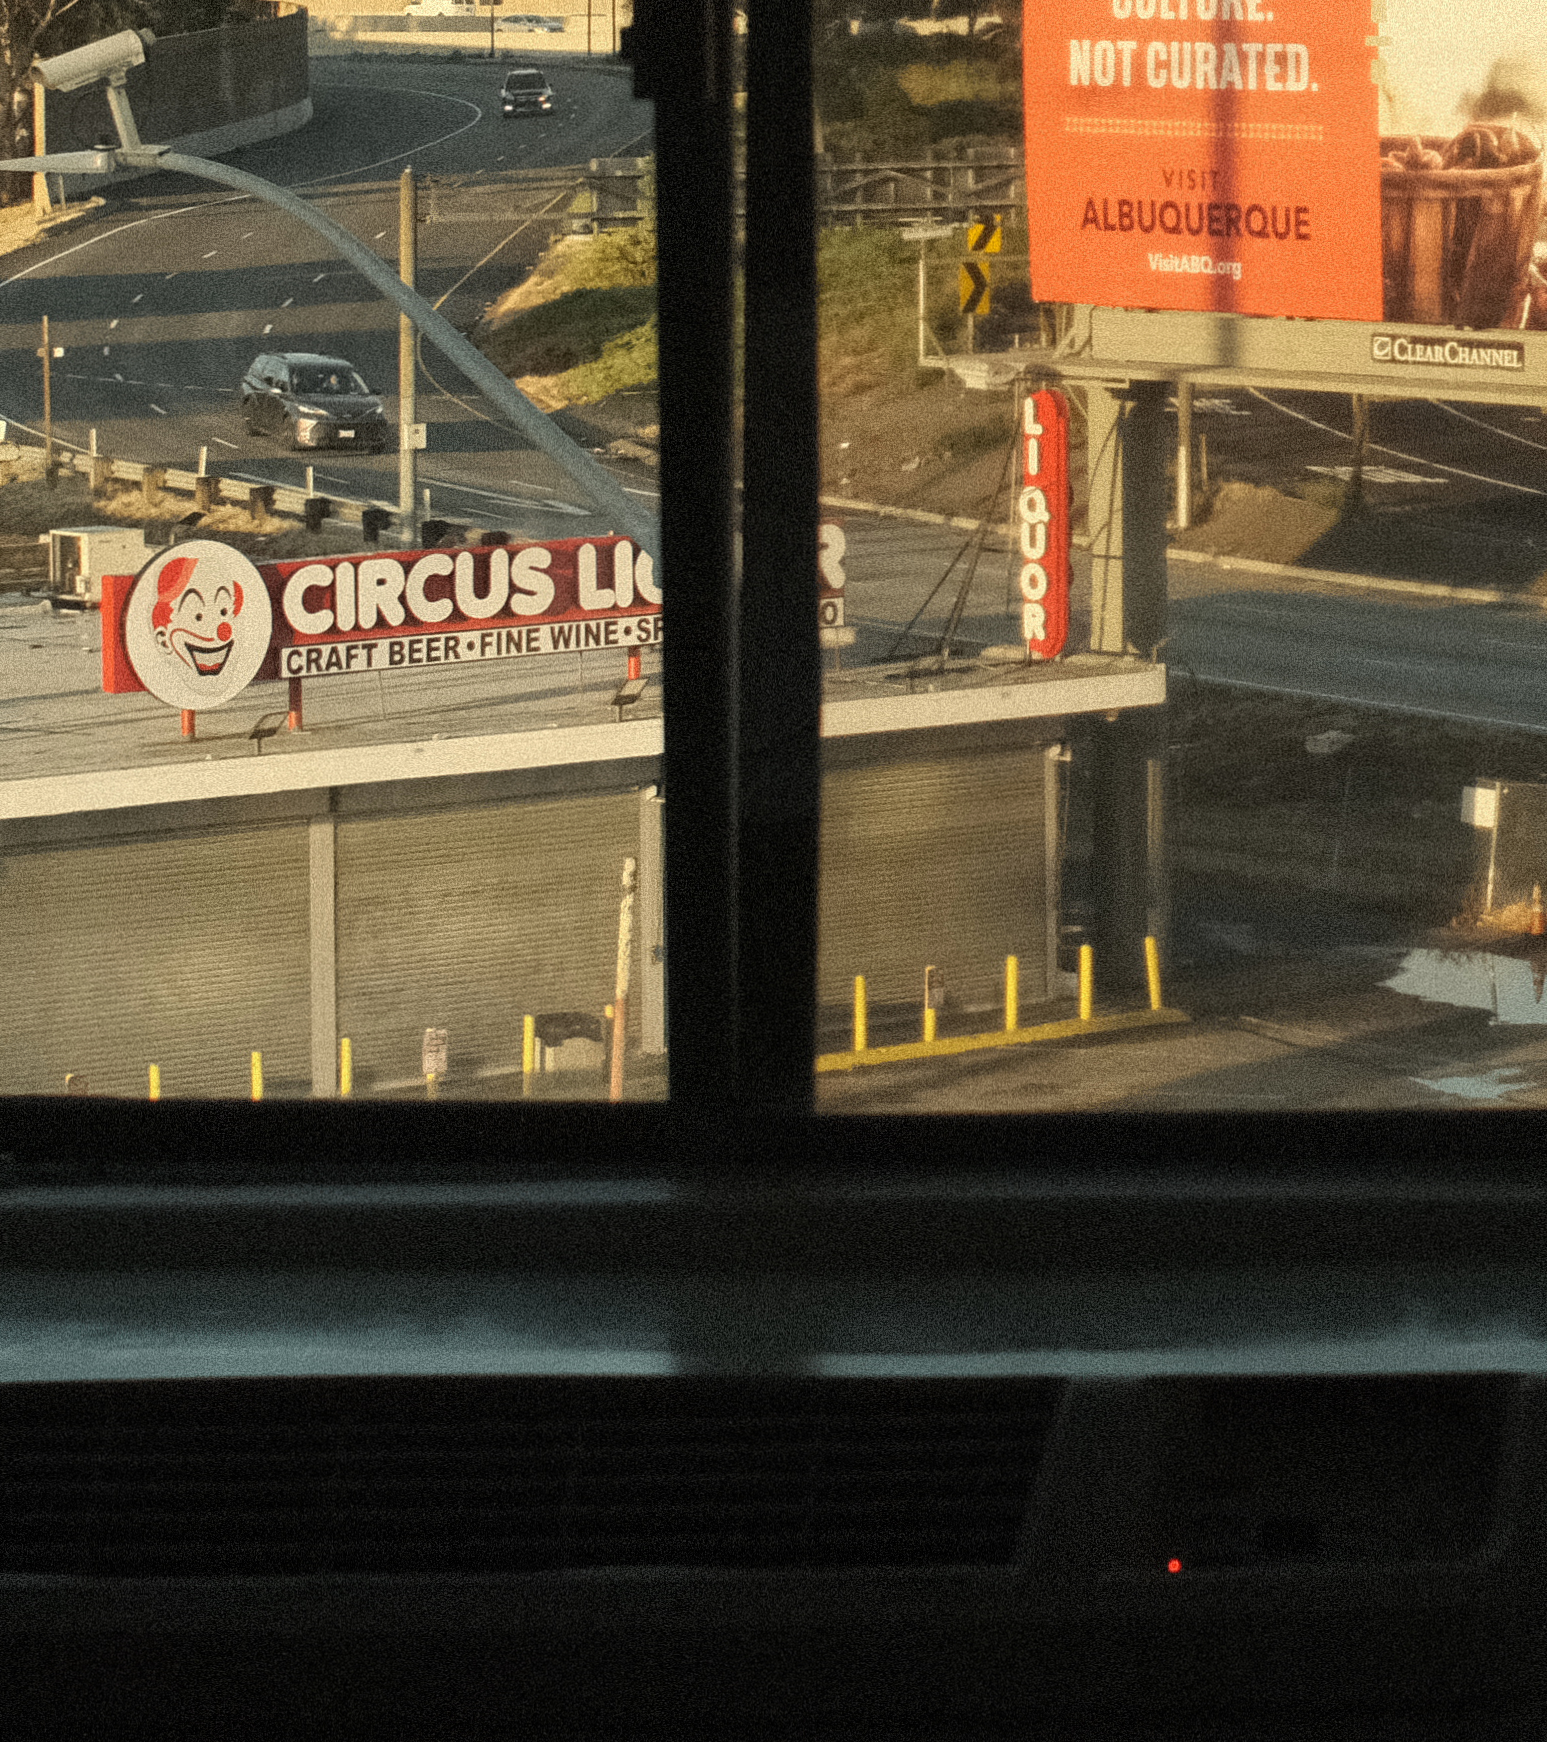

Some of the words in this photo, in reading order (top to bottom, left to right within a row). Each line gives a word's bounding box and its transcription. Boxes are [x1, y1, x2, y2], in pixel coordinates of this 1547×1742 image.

[1069, 39, 1138, 88] NOT
[1146, 41, 1319, 92] CURATED.
[1162, 168, 1221, 191] VISIT
[1080, 197, 1312, 241] ALBUQUERQUE
[1148, 252, 1243, 280] VisitABQ.org
[1019, 395, 1051, 642] LIQUOR
[282, 546, 555, 635] CIRCUS
[286, 642, 379, 675] CRAFT
[388, 636, 462, 666] BEER
[480, 627, 541, 657] FINE
[550, 619, 619, 650] WINE
